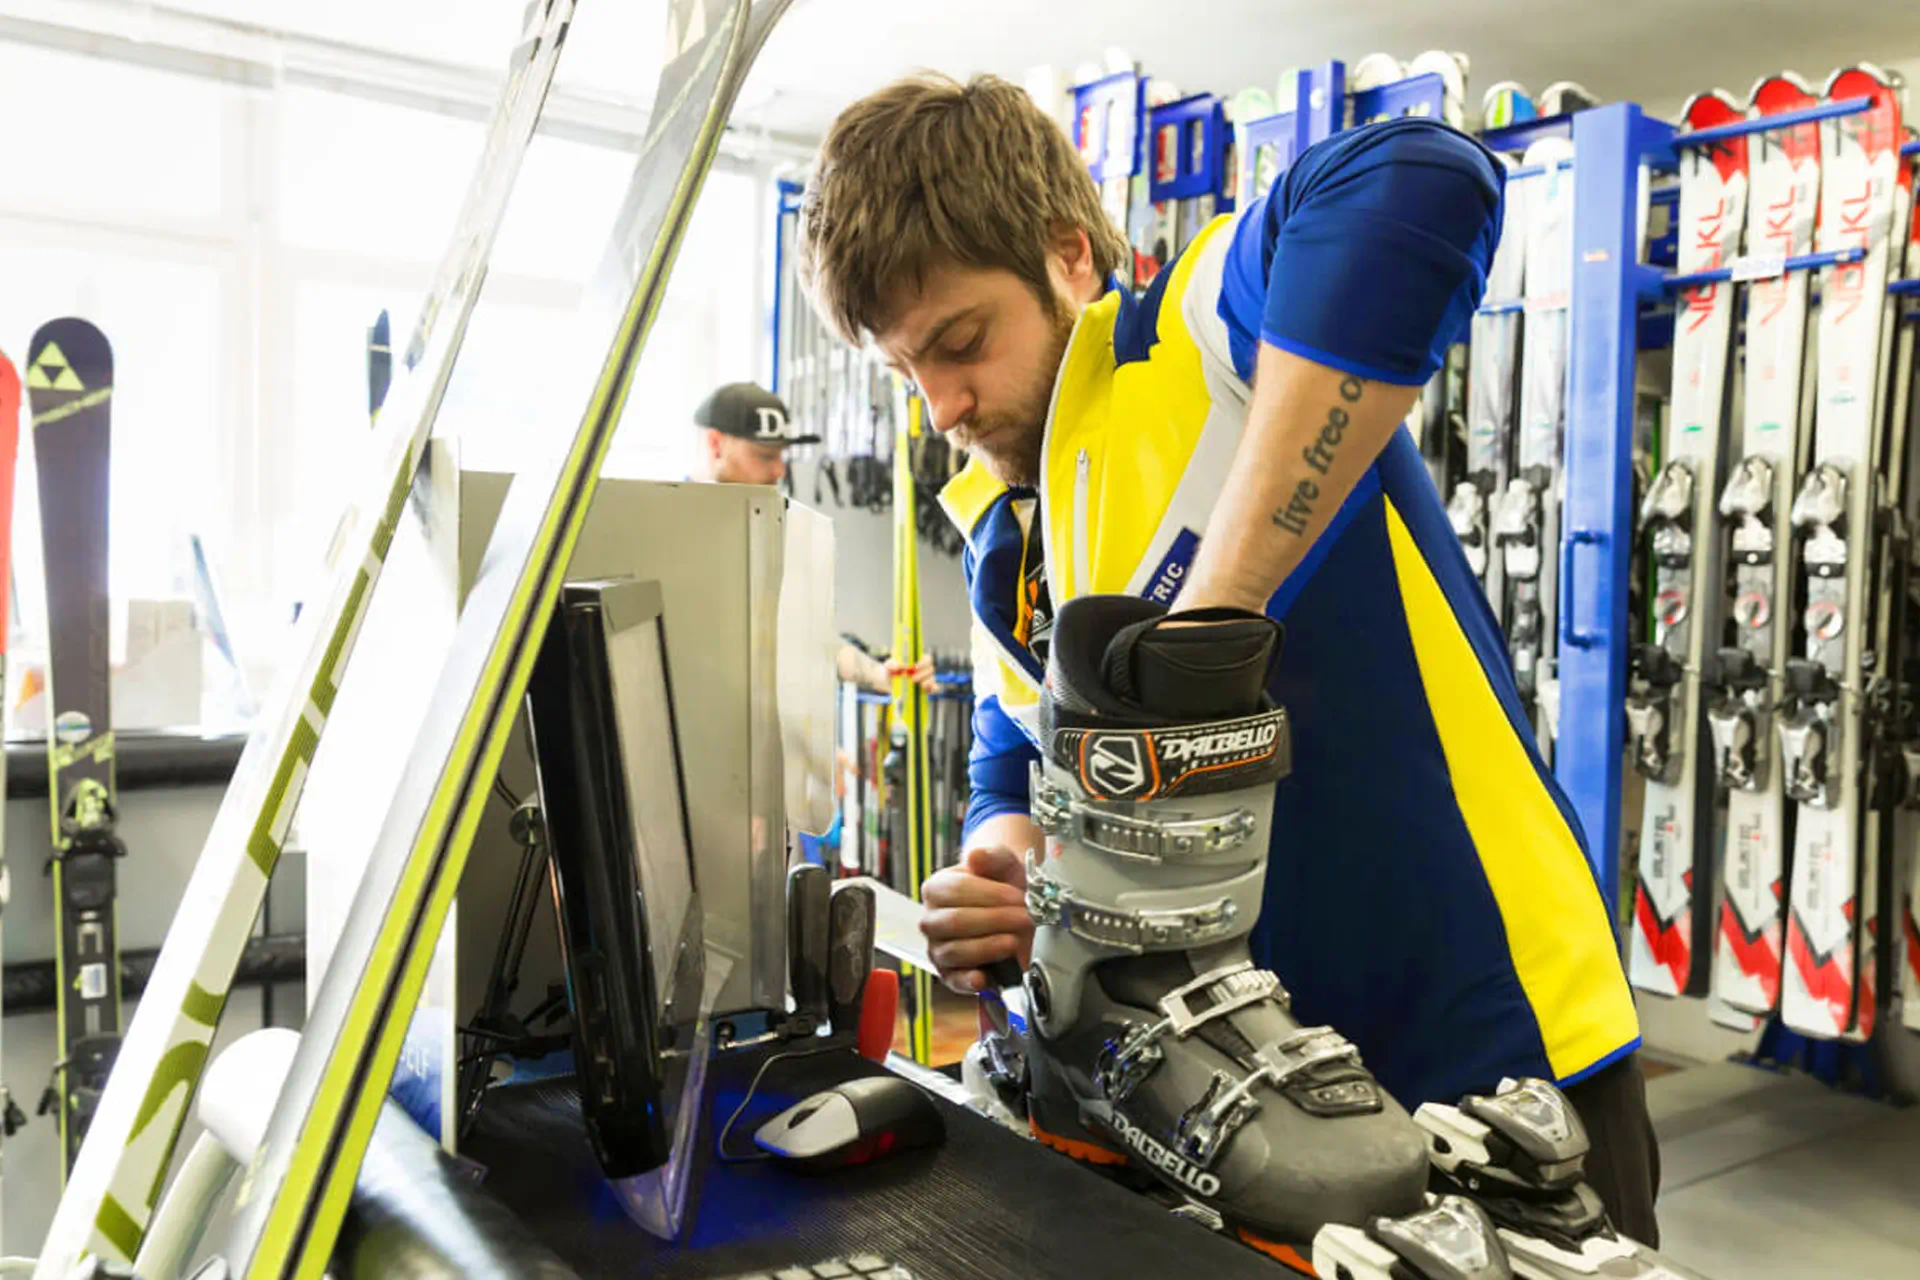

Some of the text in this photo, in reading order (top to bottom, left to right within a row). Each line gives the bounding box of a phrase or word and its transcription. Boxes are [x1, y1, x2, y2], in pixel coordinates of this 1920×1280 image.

[1271, 374, 1366, 537] live free o
[1149, 562, 1183, 601] RIC
[1160, 724, 1277, 760] DALBELLO
[1113, 1109, 1221, 1197] DALBELLO
